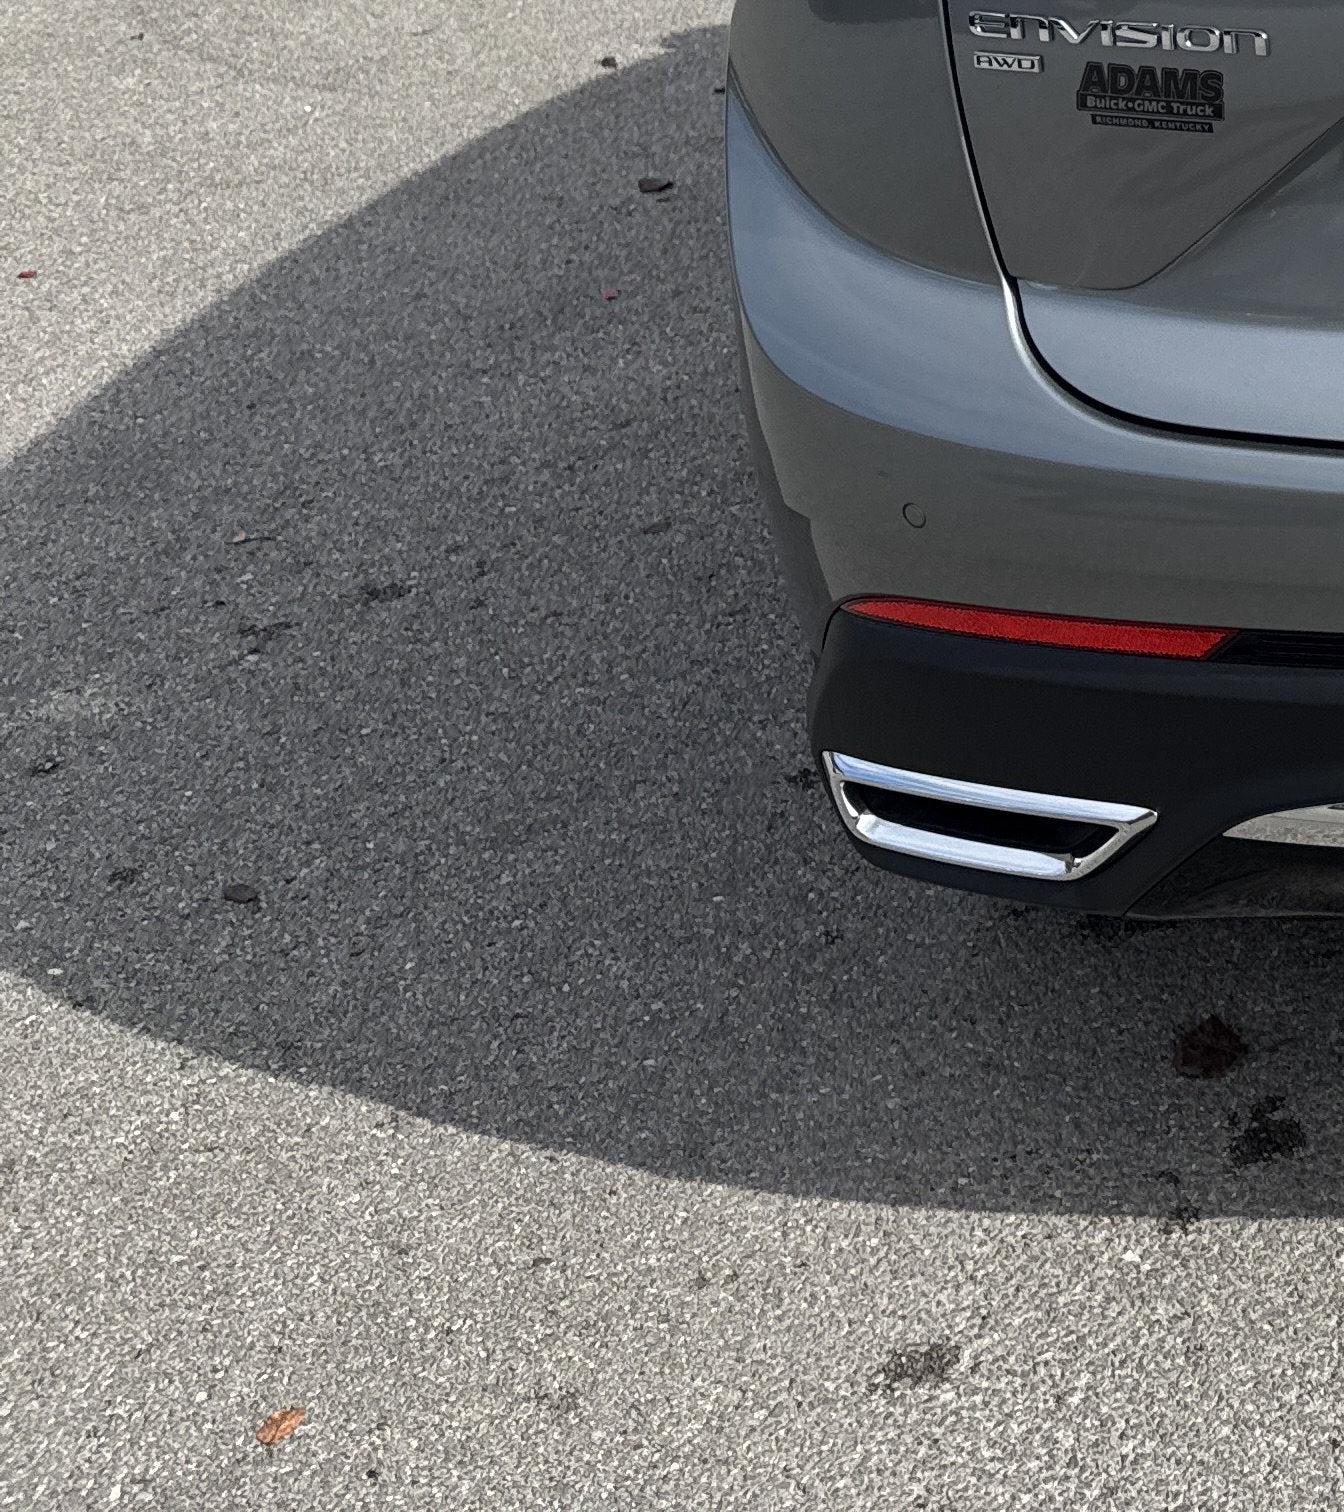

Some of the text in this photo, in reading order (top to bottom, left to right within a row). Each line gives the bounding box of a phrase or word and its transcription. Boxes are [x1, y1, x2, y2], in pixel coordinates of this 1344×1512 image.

[968, 10, 1271, 57] ENVISION
[975, 53, 1037, 72] AWD
[1079, 61, 1225, 103] ADAMS
[1171, 102, 1215, 118] Truck
[1154, 120, 1211, 133] KENTUCKY
